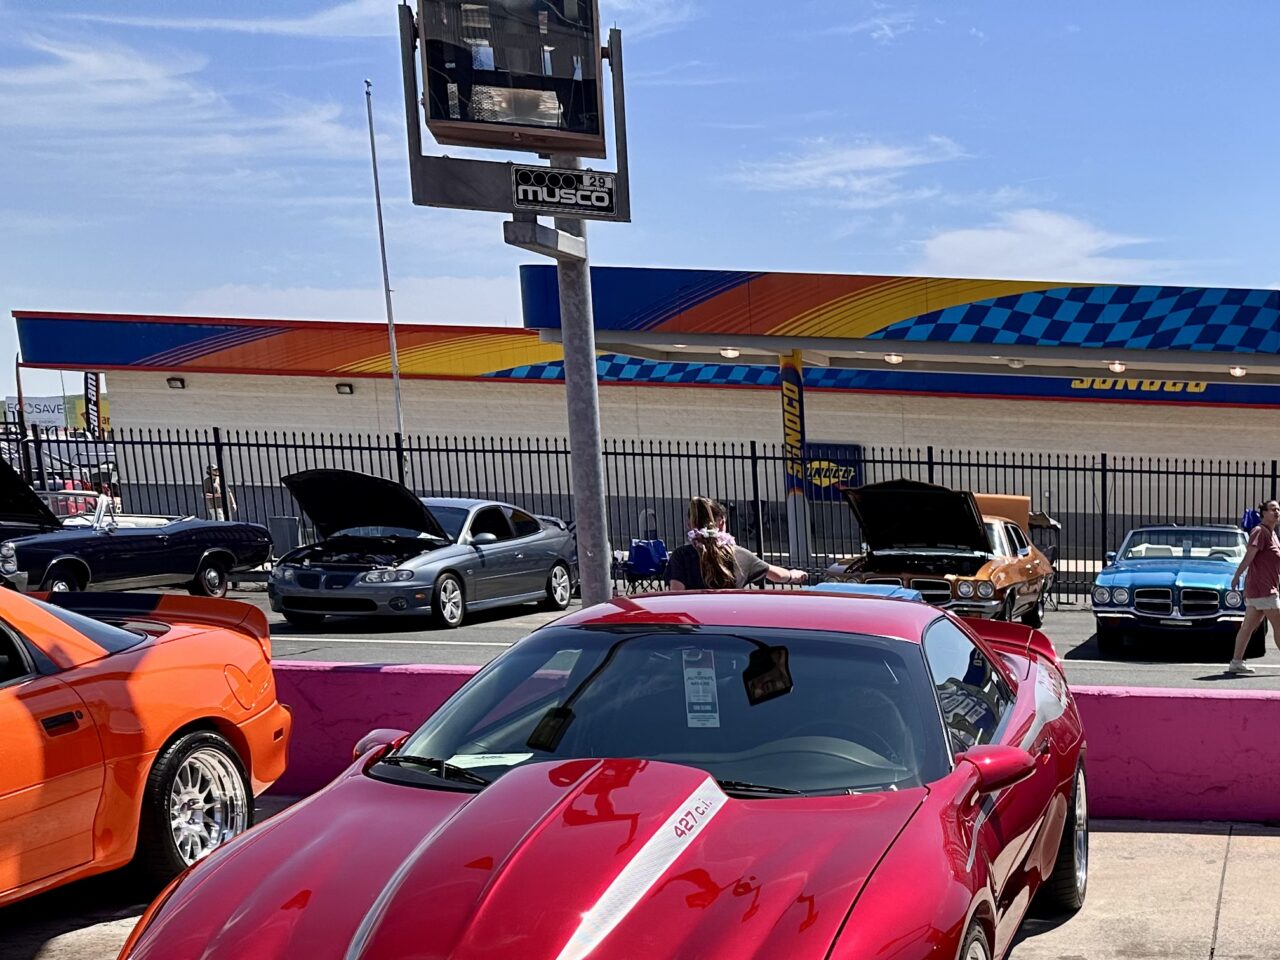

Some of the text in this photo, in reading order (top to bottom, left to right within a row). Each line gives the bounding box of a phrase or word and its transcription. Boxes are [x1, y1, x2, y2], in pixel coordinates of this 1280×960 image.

[589, 175, 606, 188] 29
[517, 185, 610, 207] musco
[782, 380, 802, 479] SUNOCO
[674, 811, 698, 838] 427
